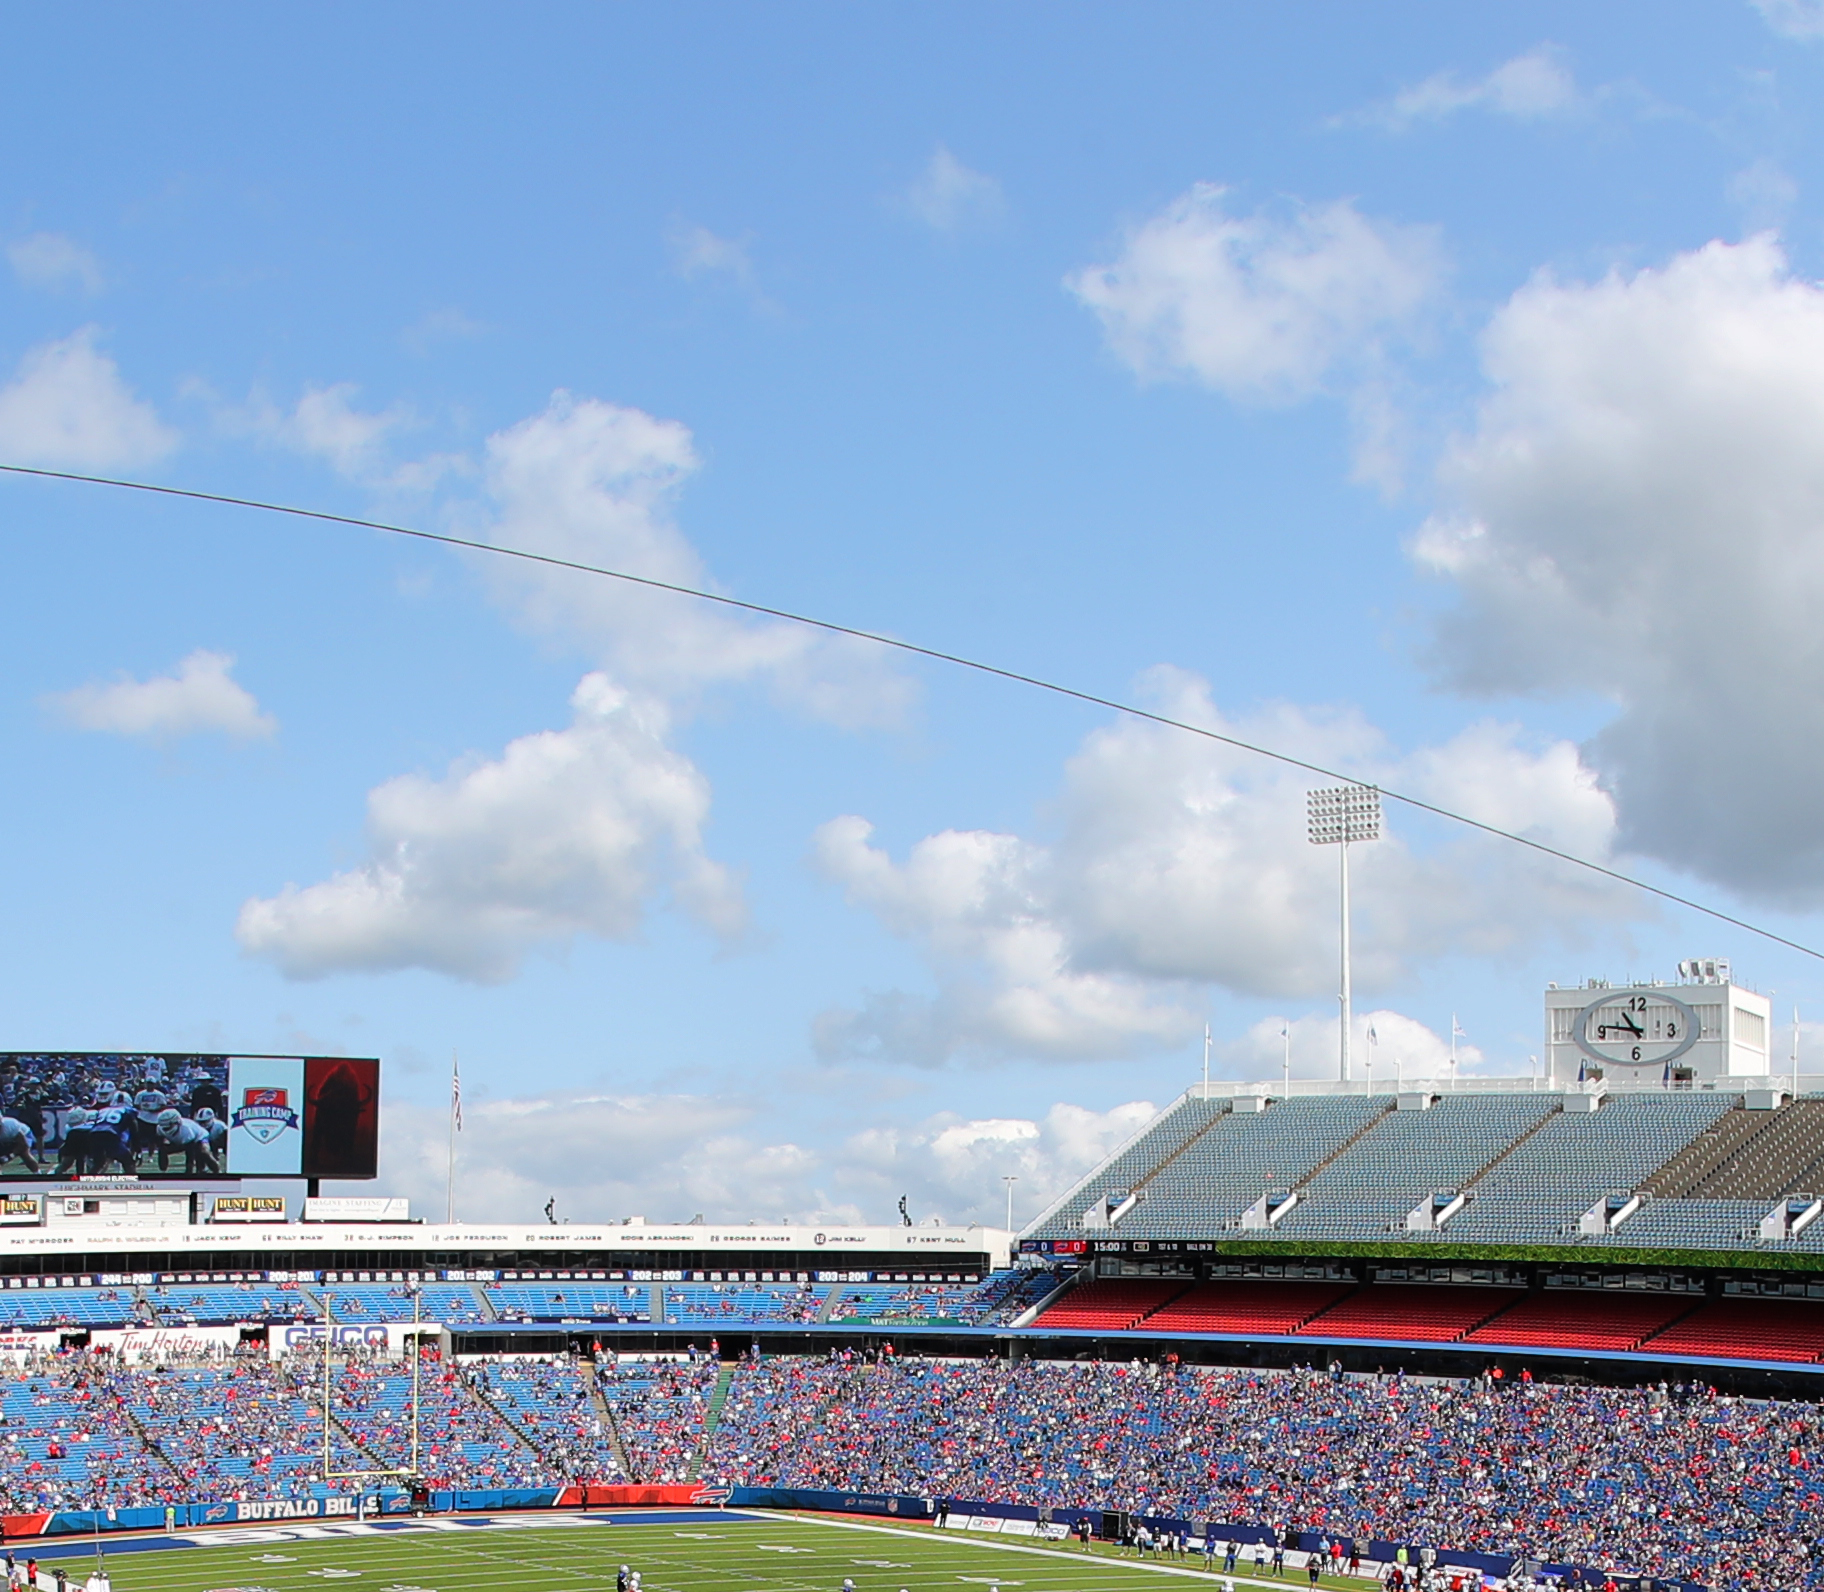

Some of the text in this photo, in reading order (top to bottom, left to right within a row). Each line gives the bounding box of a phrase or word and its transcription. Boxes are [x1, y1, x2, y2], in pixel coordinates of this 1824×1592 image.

[1628, 997, 1647, 1012] 12
[1597, 1025, 1606, 1040] 9
[1666, 1023, 1676, 1038] 3
[1631, 1046, 1641, 1061] 6
[239, 1106, 293, 1122] TRAINING CAMP
[5, 1201, 36, 1212] HUNT
[219, 1199, 247, 1210] HUNT
[252, 1199, 282, 1210] HUNT
[1040, 1241, 1048, 1251] 0
[1073, 1241, 1081, 1251] 0
[1093, 1242, 1121, 1252] 15:00
[101, 1274, 122, 1285] 244
[132, 1273, 153, 1284] 200
[268, 1271, 289, 1282] 200
[297, 1271, 316, 1282] 201
[447, 1270, 466, 1281] 201
[475, 1270, 495, 1281] 202
[632, 1270, 652, 1281] 202
[662, 1270, 682, 1281] 203
[818, 1270, 838, 1282] 203
[848, 1270, 868, 1282] 204
[120, 1330, 212, 1351] Tim Hortons
[284, 1326, 389, 1348] GEICO
[237, 1496, 379, 1520] BUFFALO BILS
